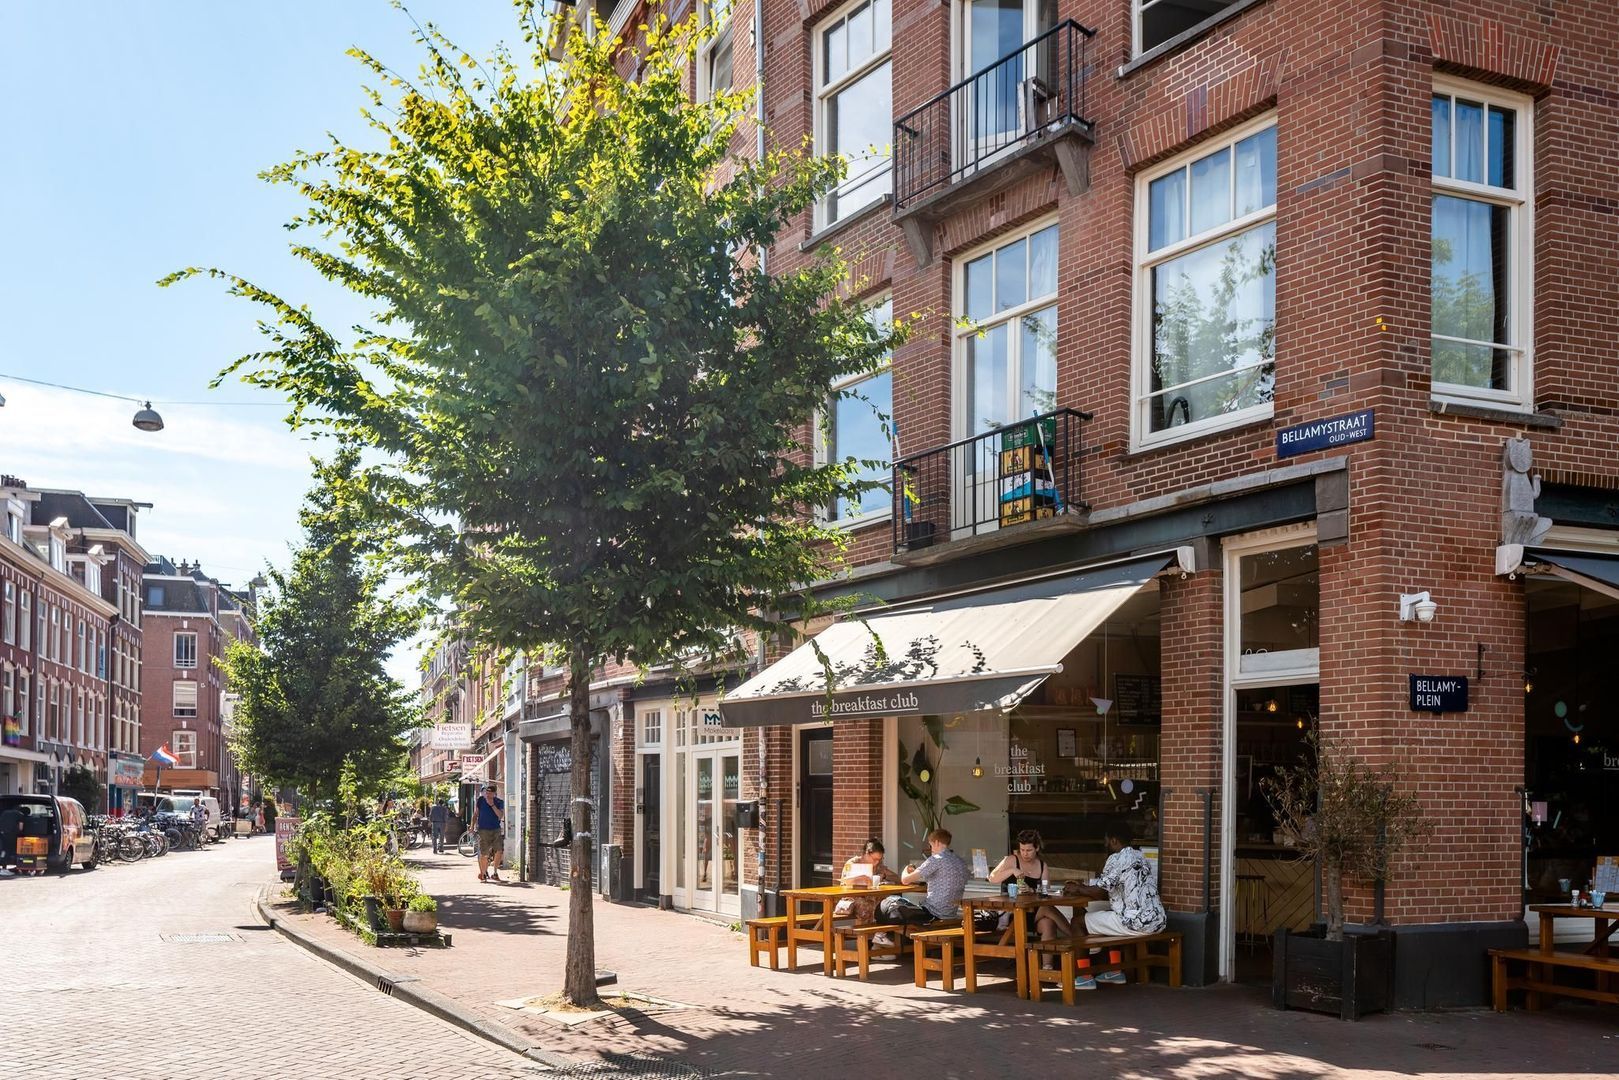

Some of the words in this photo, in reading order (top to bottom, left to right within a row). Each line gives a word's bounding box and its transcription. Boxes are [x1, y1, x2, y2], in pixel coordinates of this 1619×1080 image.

[1282, 415, 1367, 444] BELLAMYSTRAAT
[1329, 428, 1367, 443] OUD-WEST
[1416, 680, 1461, 692] BELLAMY-
[832, 695, 888, 713] breakfast
[890, 692, 919, 709] club
[1416, 694, 1441, 706] PLEIN
[1010, 744, 1028, 757] the
[994, 761, 1046, 775] breakfast
[1007, 779, 1031, 792] club
